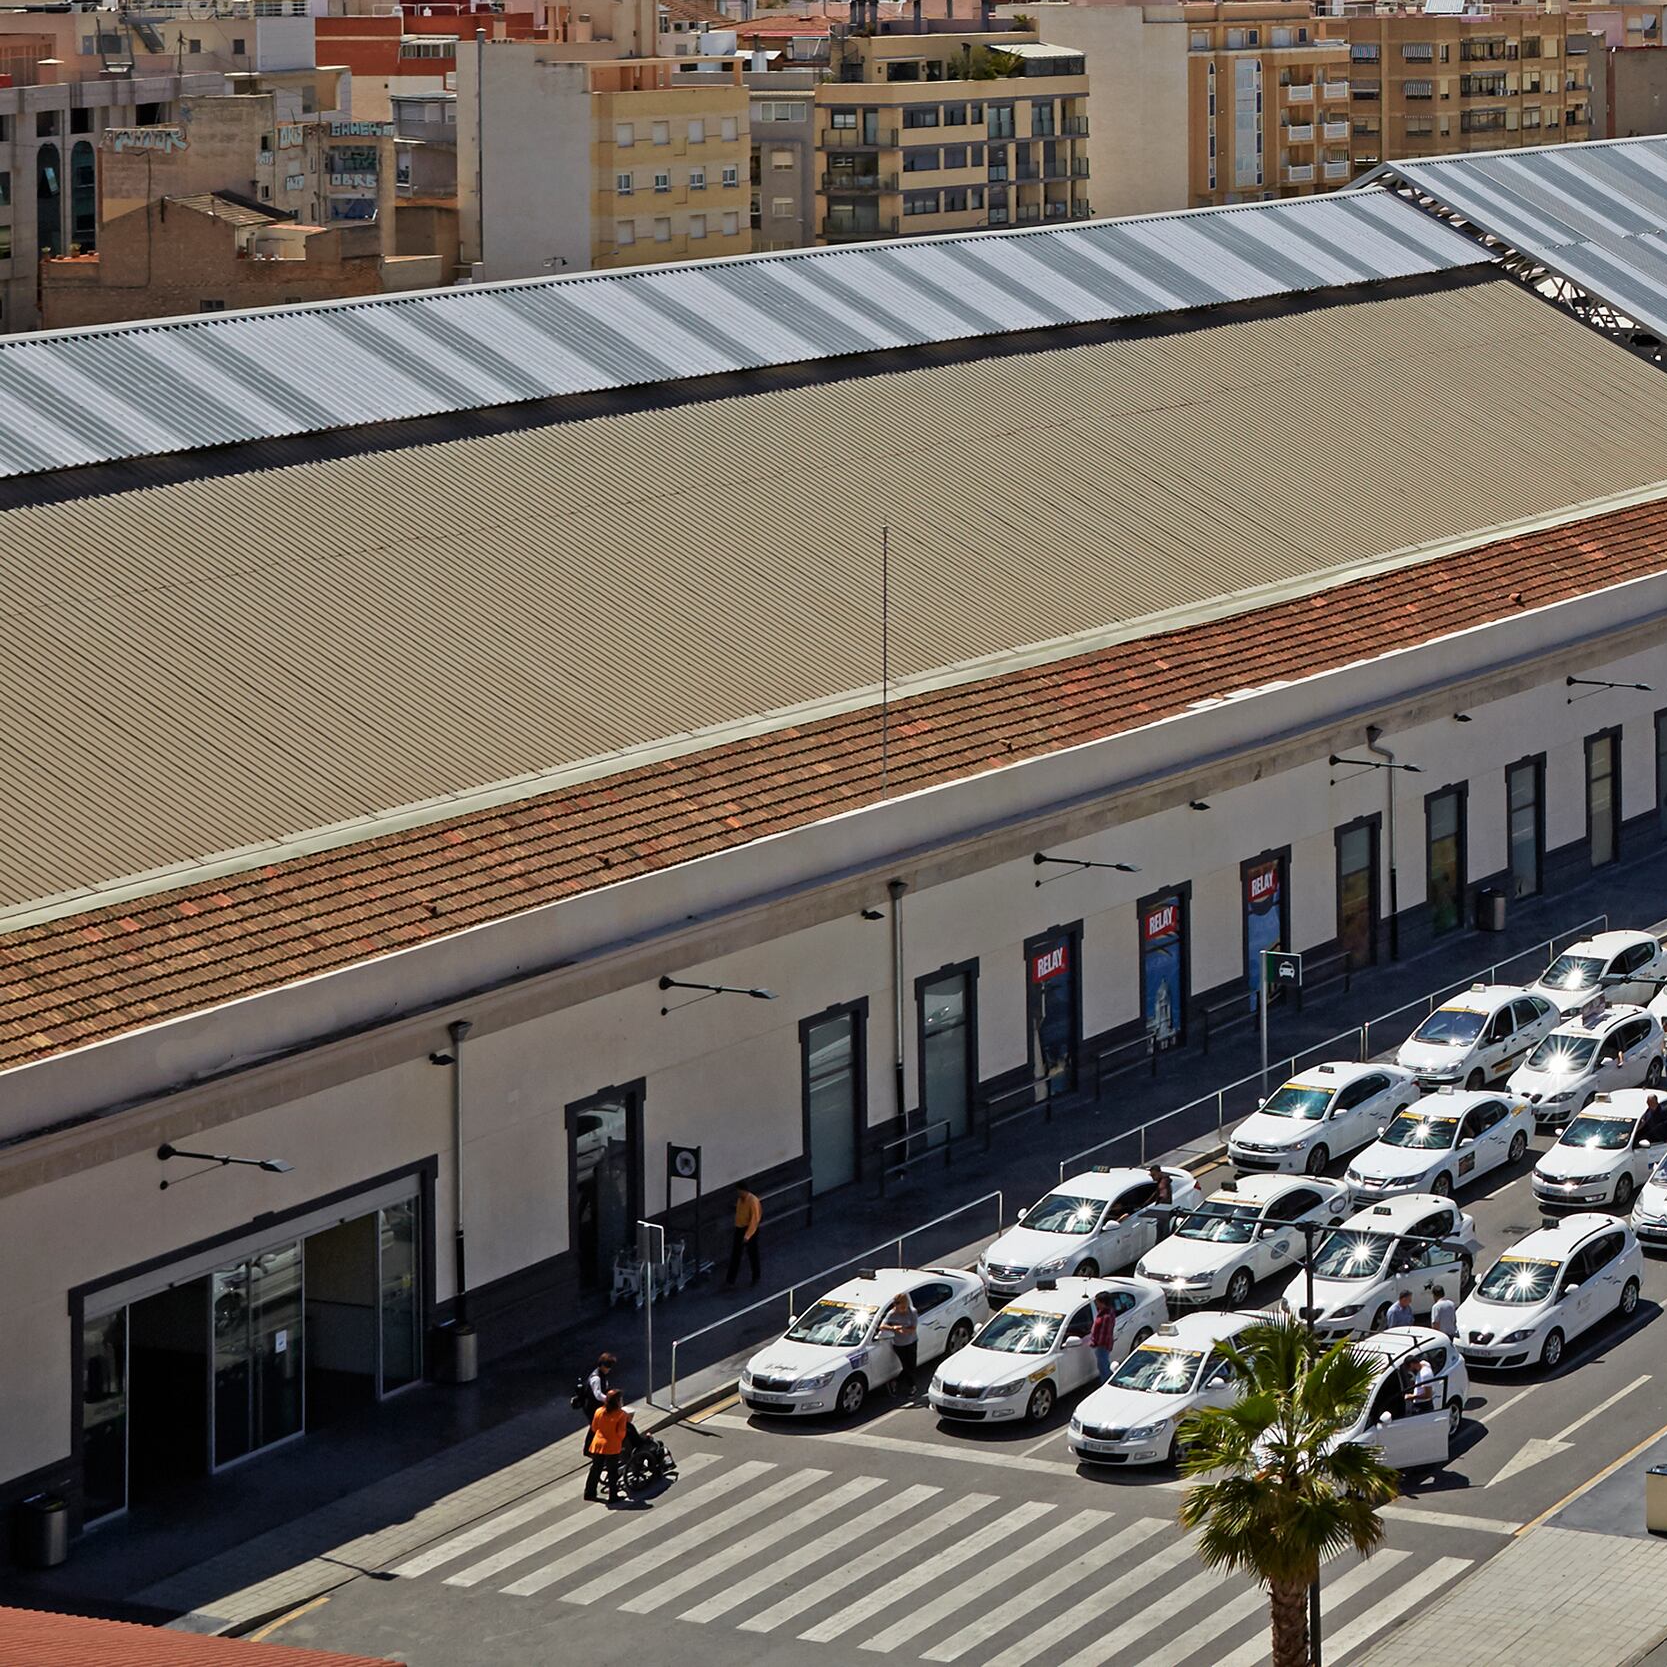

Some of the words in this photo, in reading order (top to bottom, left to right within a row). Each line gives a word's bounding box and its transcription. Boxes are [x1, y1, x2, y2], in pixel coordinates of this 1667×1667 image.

[1252, 872, 1274, 898] RELAY
[1148, 907, 1174, 936] RELAY
[1036, 947, 1064, 978] RELAY
